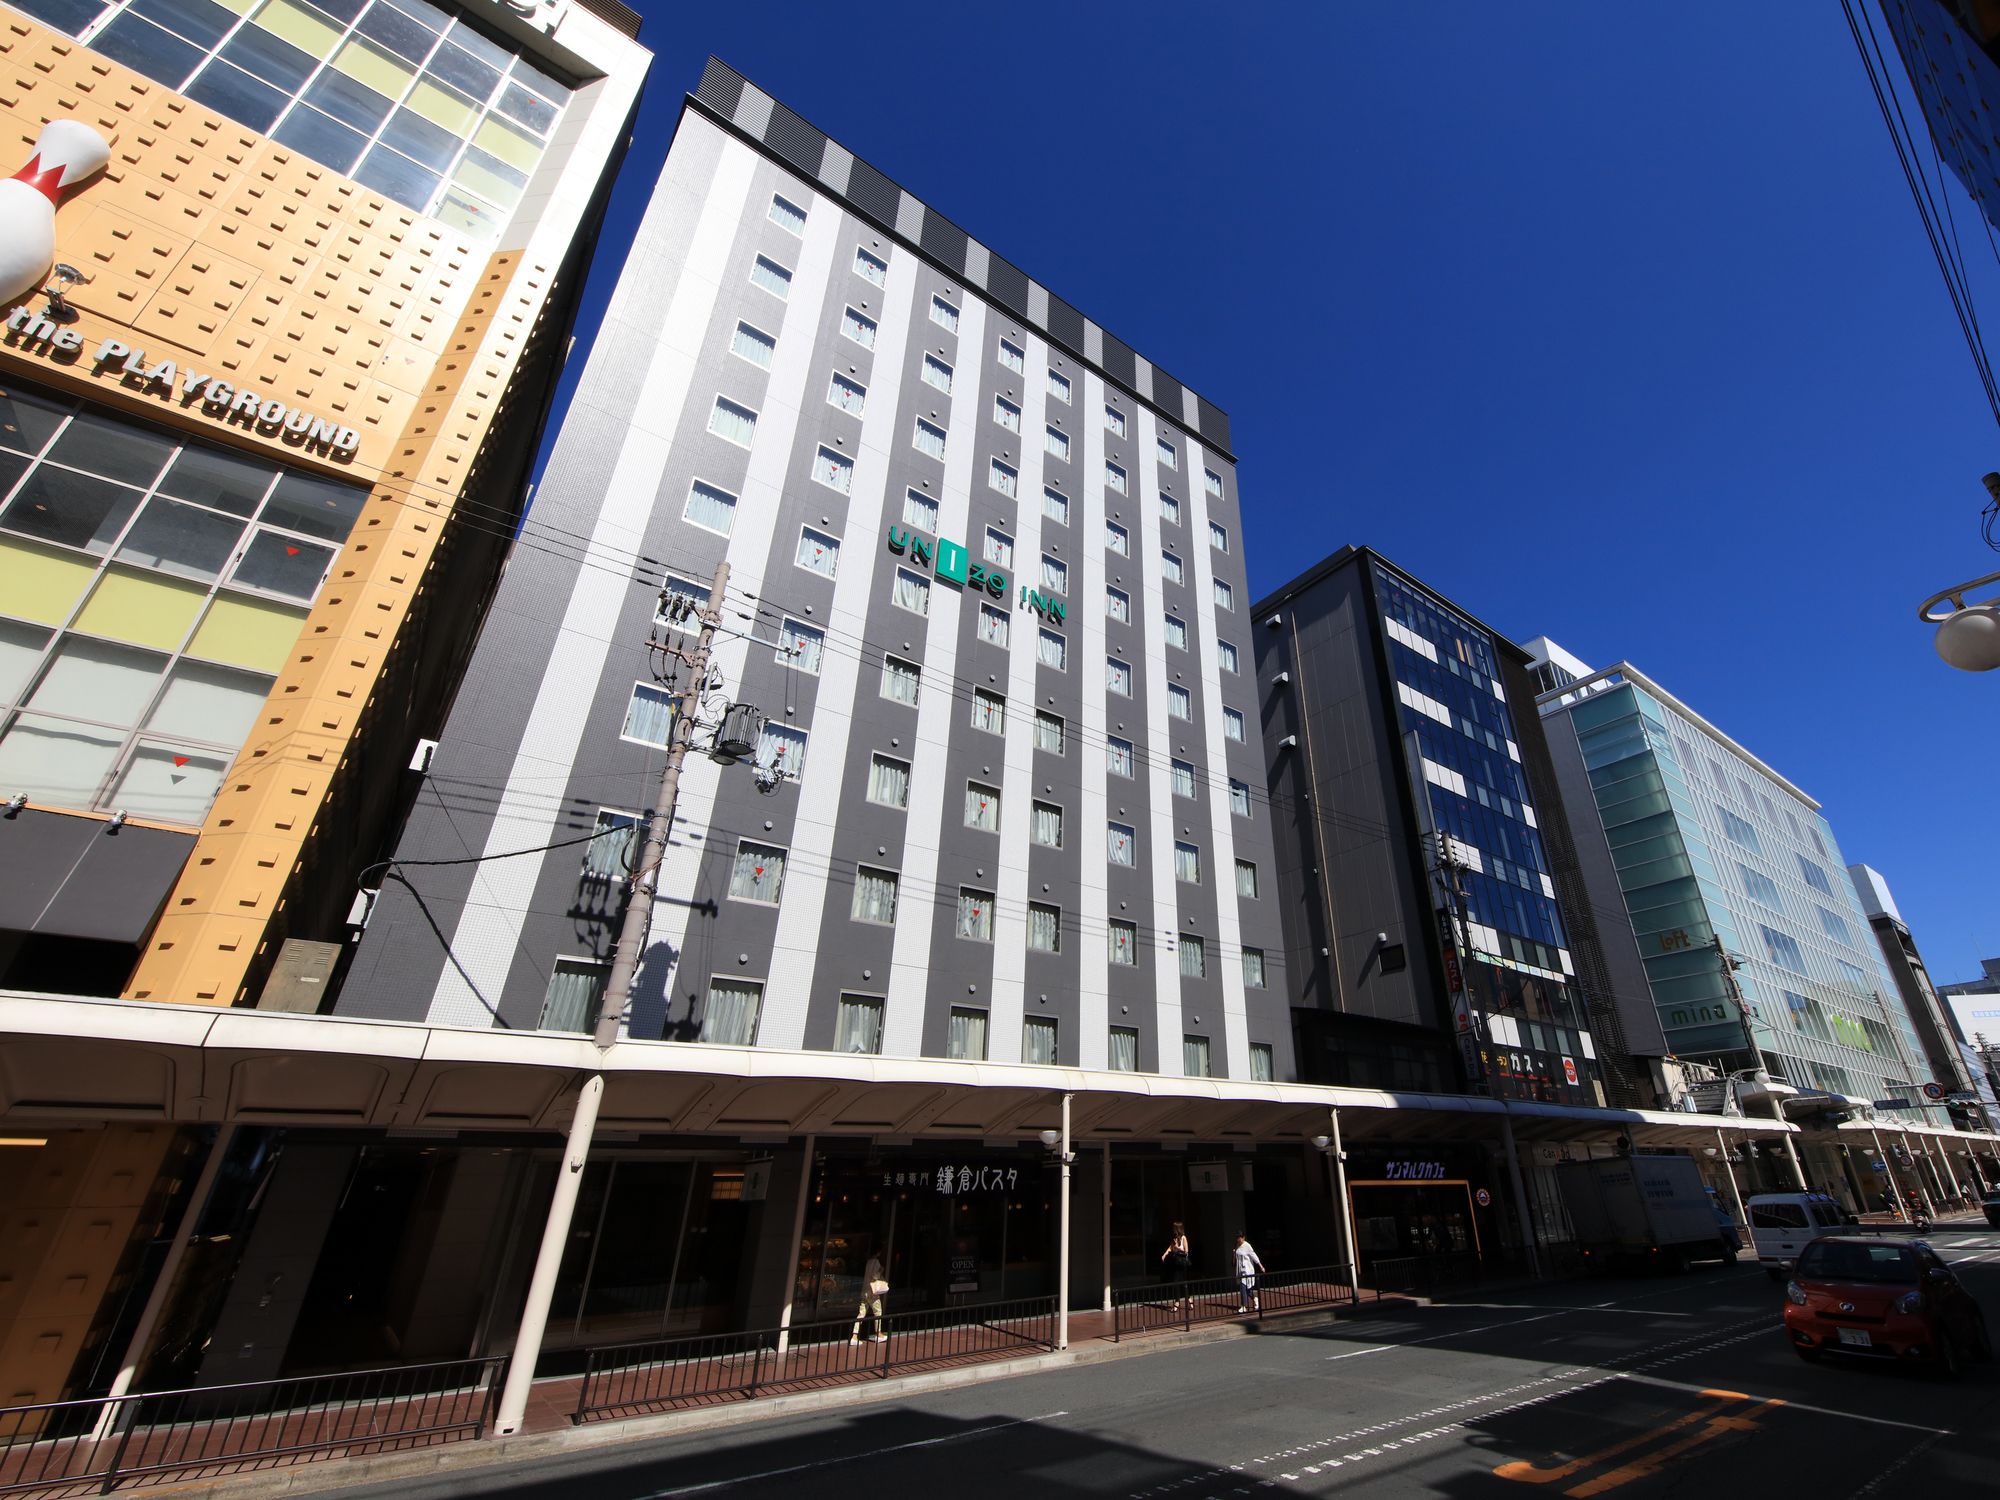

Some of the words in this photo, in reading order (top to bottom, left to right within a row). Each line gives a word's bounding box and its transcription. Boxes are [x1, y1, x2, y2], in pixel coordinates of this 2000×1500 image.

[6, 305, 84, 352] the
[93, 338, 361, 453] PLAYGROUND
[889, 525, 1008, 591] UNIZO
[1021, 585, 1067, 619] INN
[1671, 1004, 1727, 1025] mina
[936, 1165, 1018, 1195] 鎌倉パスタ
[1386, 1161, 1446, 1179] サンマルクカフェ
